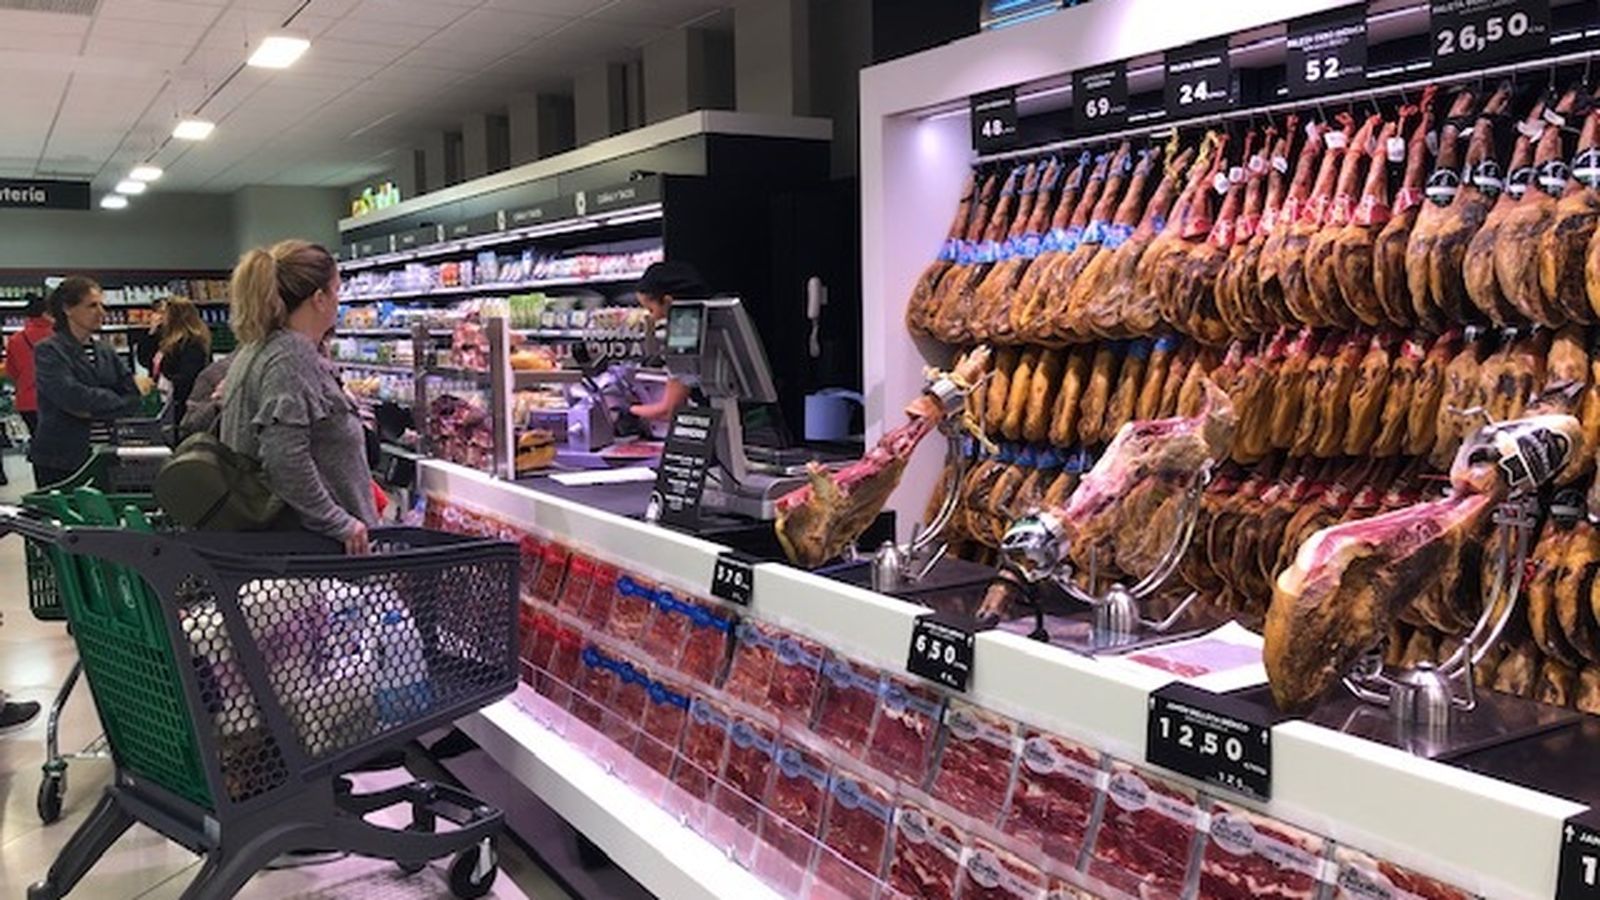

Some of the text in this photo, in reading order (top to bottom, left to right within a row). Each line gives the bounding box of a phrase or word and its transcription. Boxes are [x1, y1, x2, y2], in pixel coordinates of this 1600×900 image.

[1437, 12, 1528, 56] 26,50
[1305, 57, 1340, 81] 52
[1179, 80, 1208, 104] 24
[1085, 97, 1110, 118] 69
[981, 119, 1003, 137] 48
[915, 634, 956, 665] 6,50
[1160, 717, 1243, 762] 12,50
